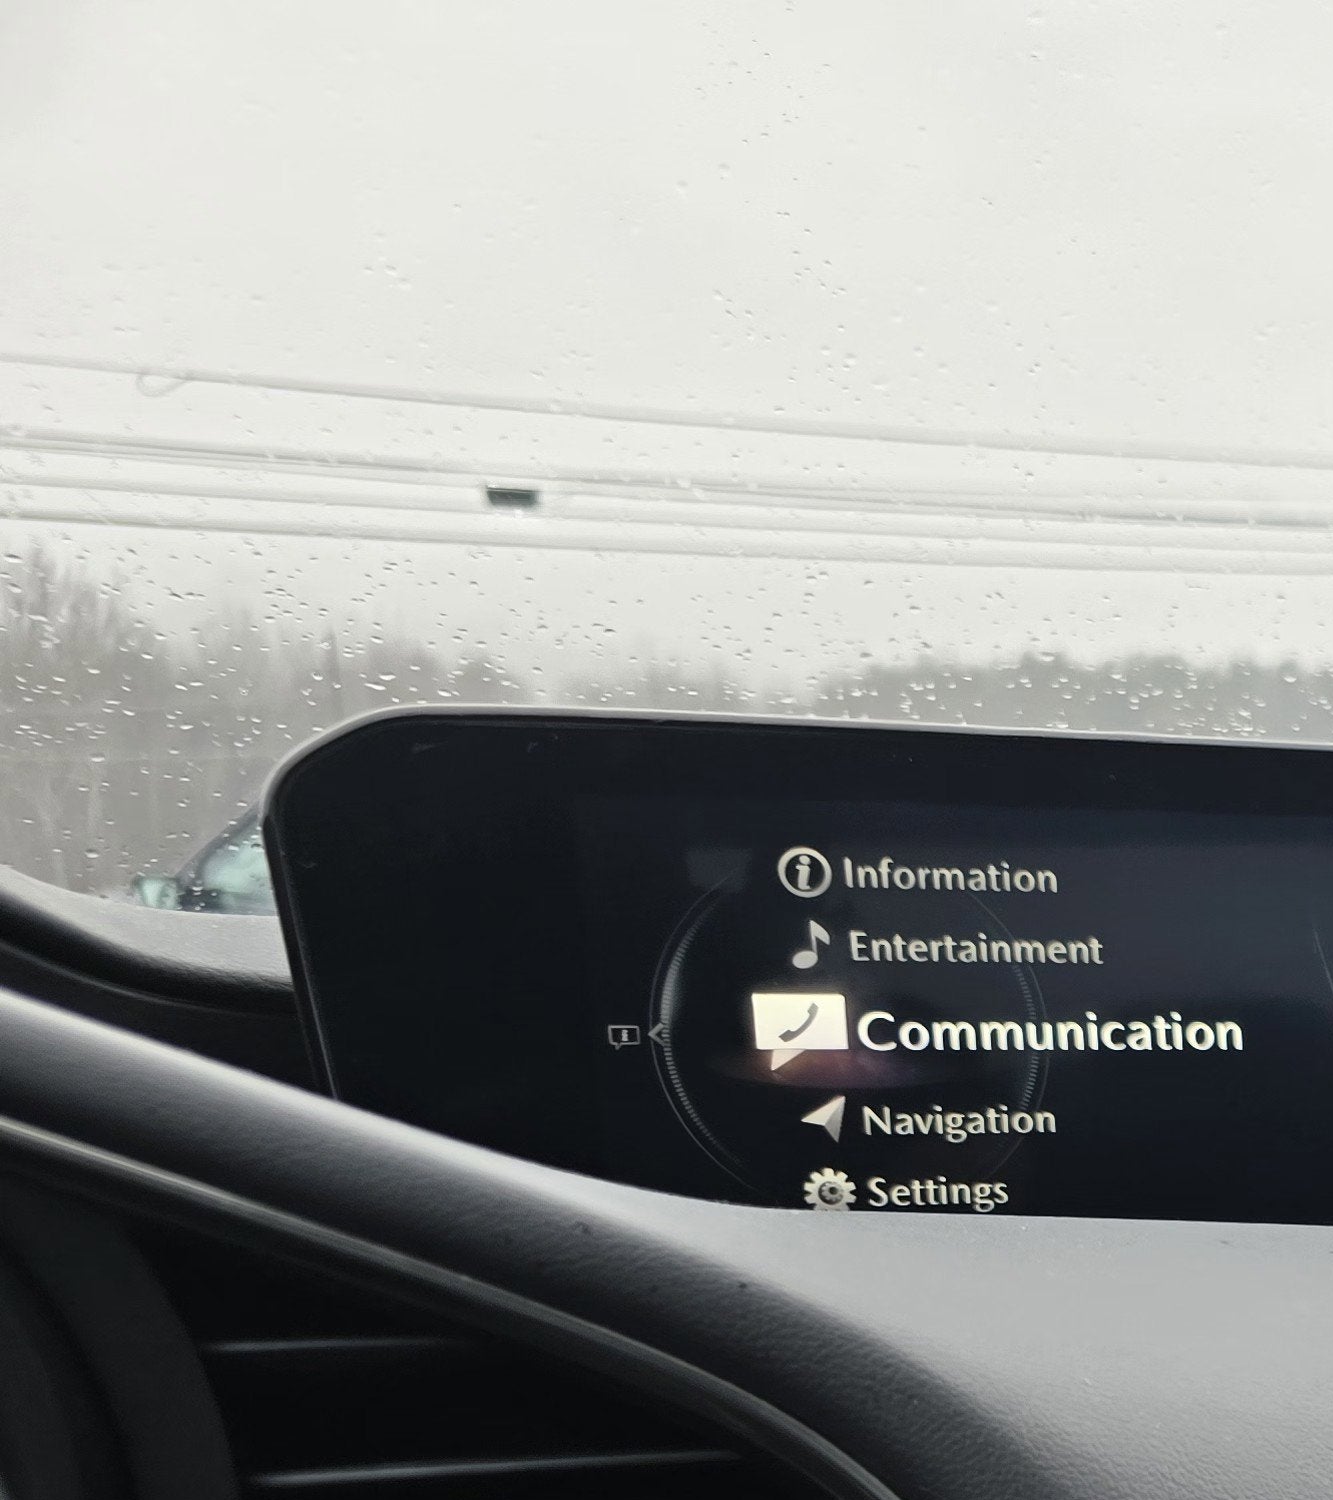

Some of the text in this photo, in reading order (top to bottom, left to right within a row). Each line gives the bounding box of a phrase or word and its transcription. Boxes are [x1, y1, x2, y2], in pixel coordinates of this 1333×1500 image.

[843, 856, 1058, 894] Information
[849, 929, 1104, 966] Entertainment
[857, 1010, 1244, 1052] Communication
[862, 1105, 1057, 1144] Navigation
[868, 1175, 1009, 1211] Settings
